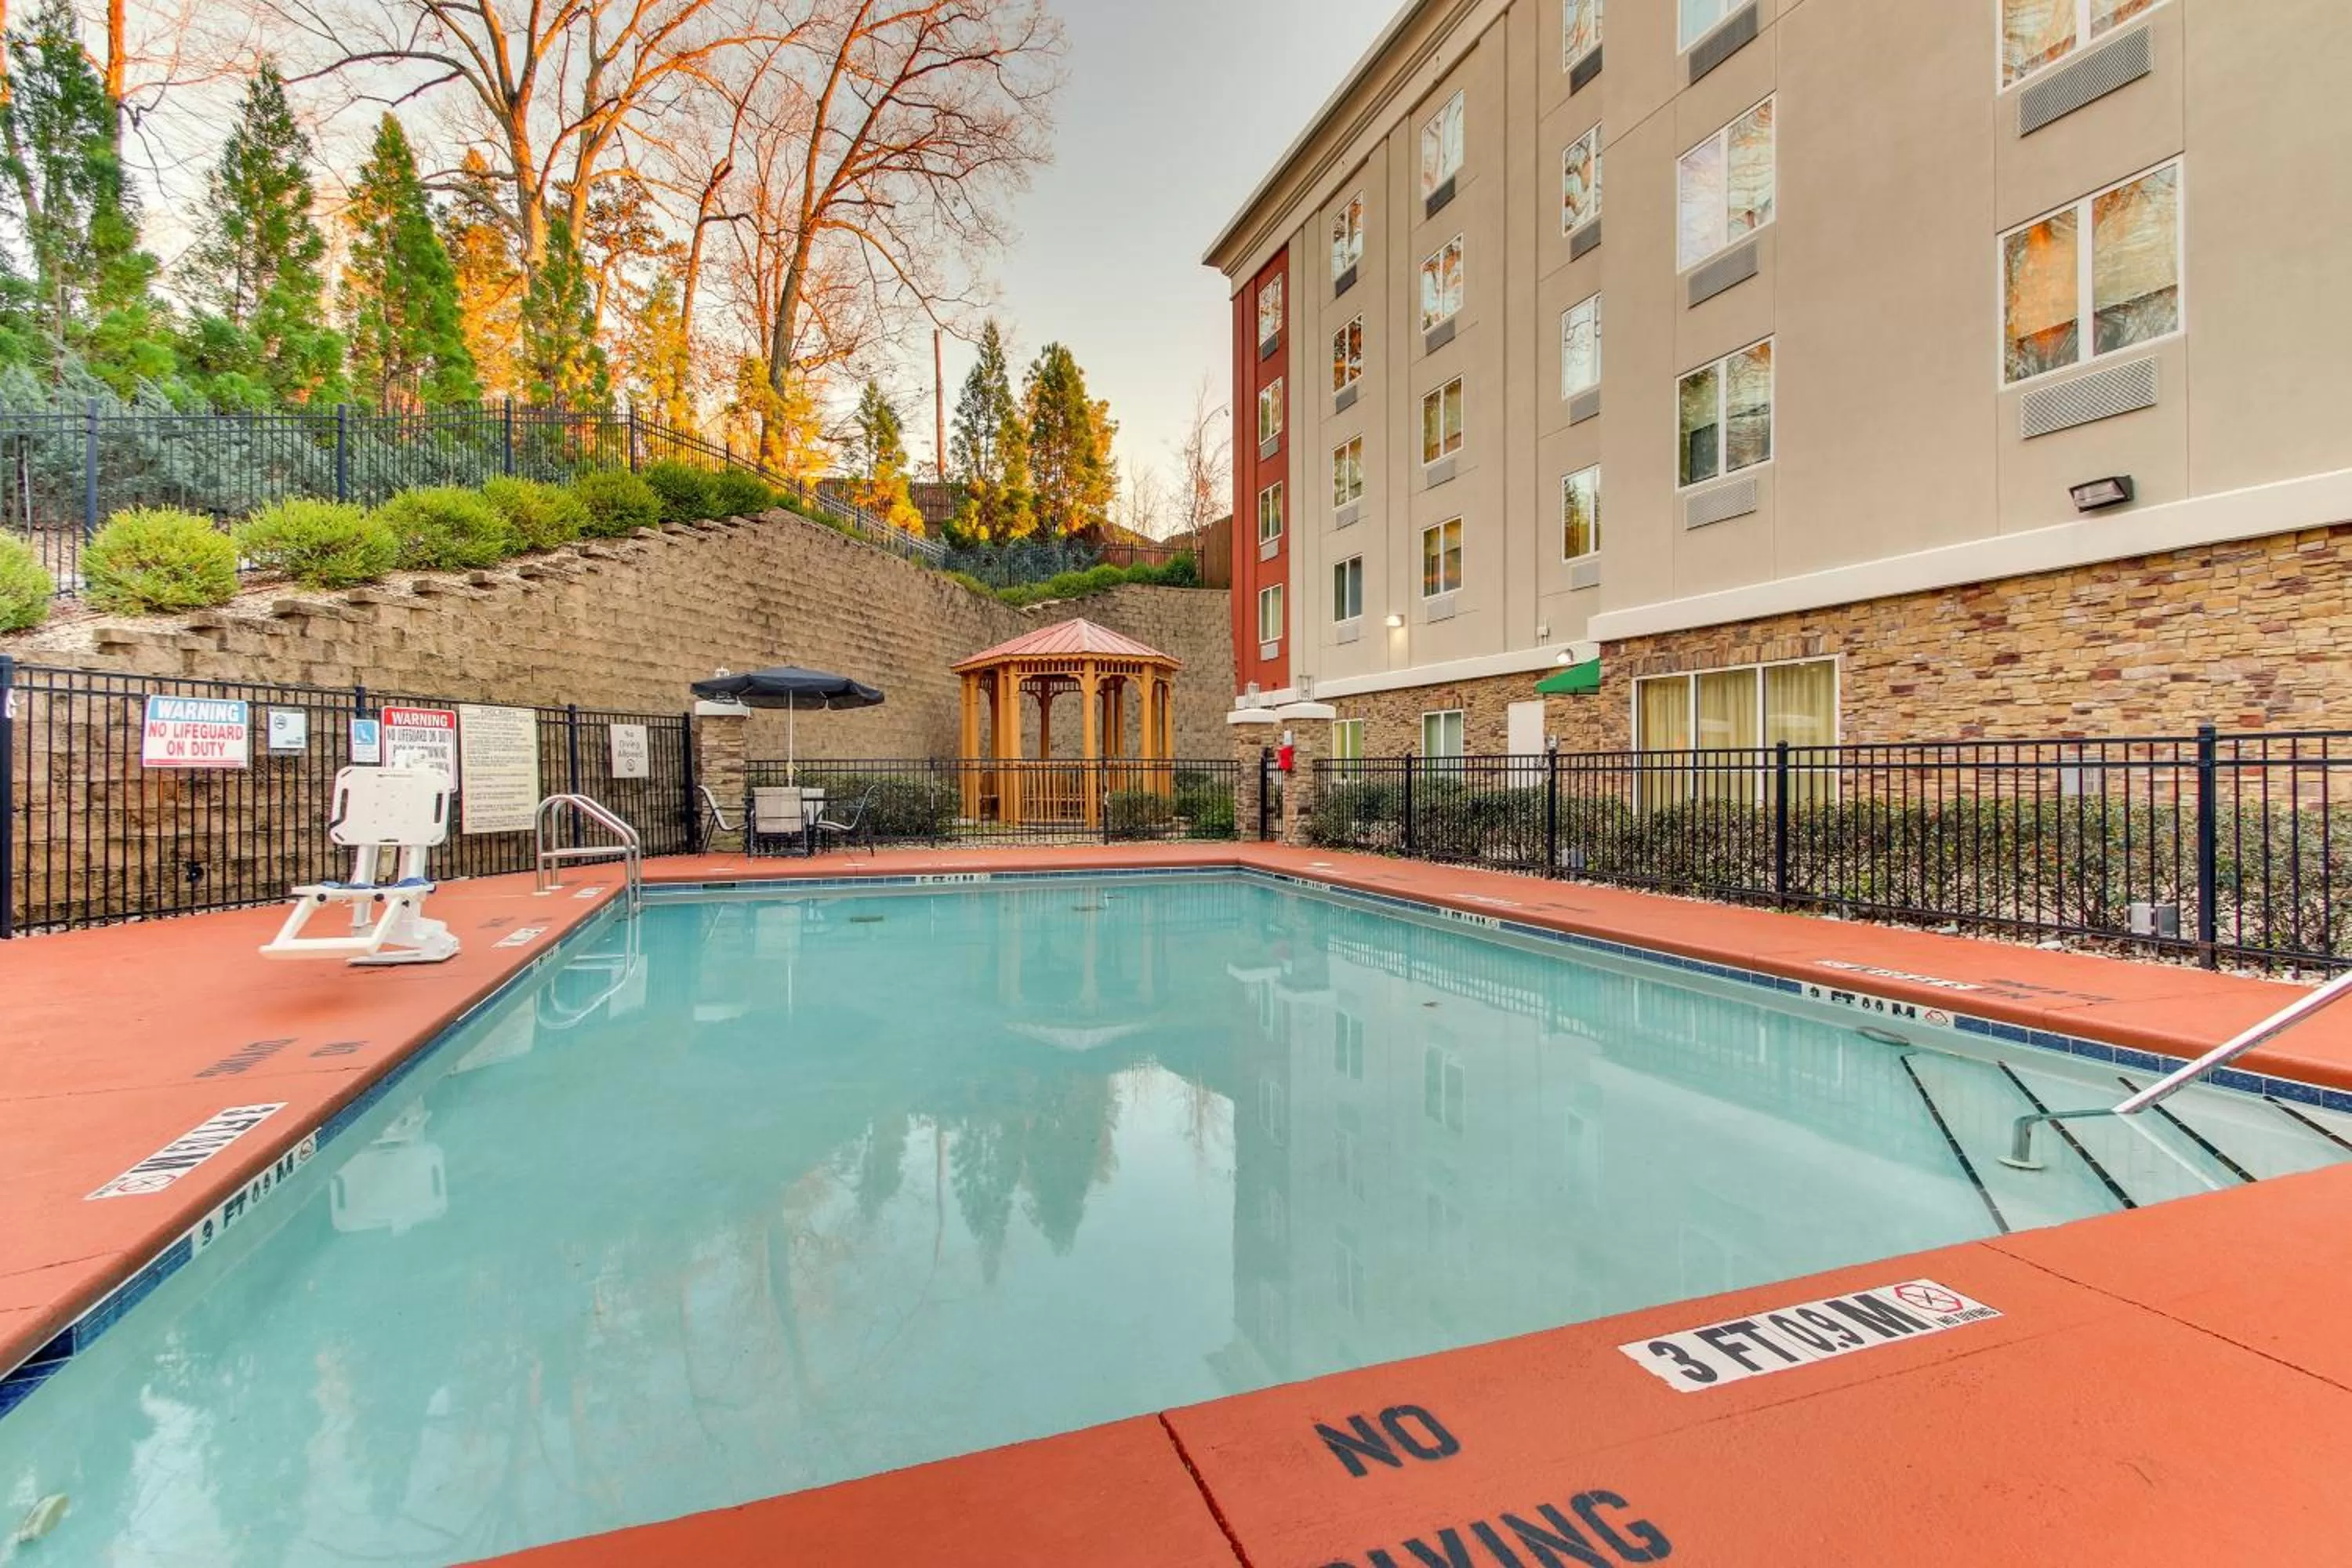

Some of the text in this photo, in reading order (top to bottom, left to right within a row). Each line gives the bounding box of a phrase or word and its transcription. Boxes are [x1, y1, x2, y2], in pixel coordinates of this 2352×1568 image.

[158, 700, 239, 721] WARNING
[392, 711, 448, 727] WARNING
[148, 721, 243, 740] NO LIFEGUARD
[166, 740, 226, 757] ON DUTY
[223, 1189, 248, 1229] FT
[276, 1152, 294, 1185] M
[1647, 1294, 1933, 1383] 3 FT 0.9 M
[1313, 1404, 1461, 1477] NO
